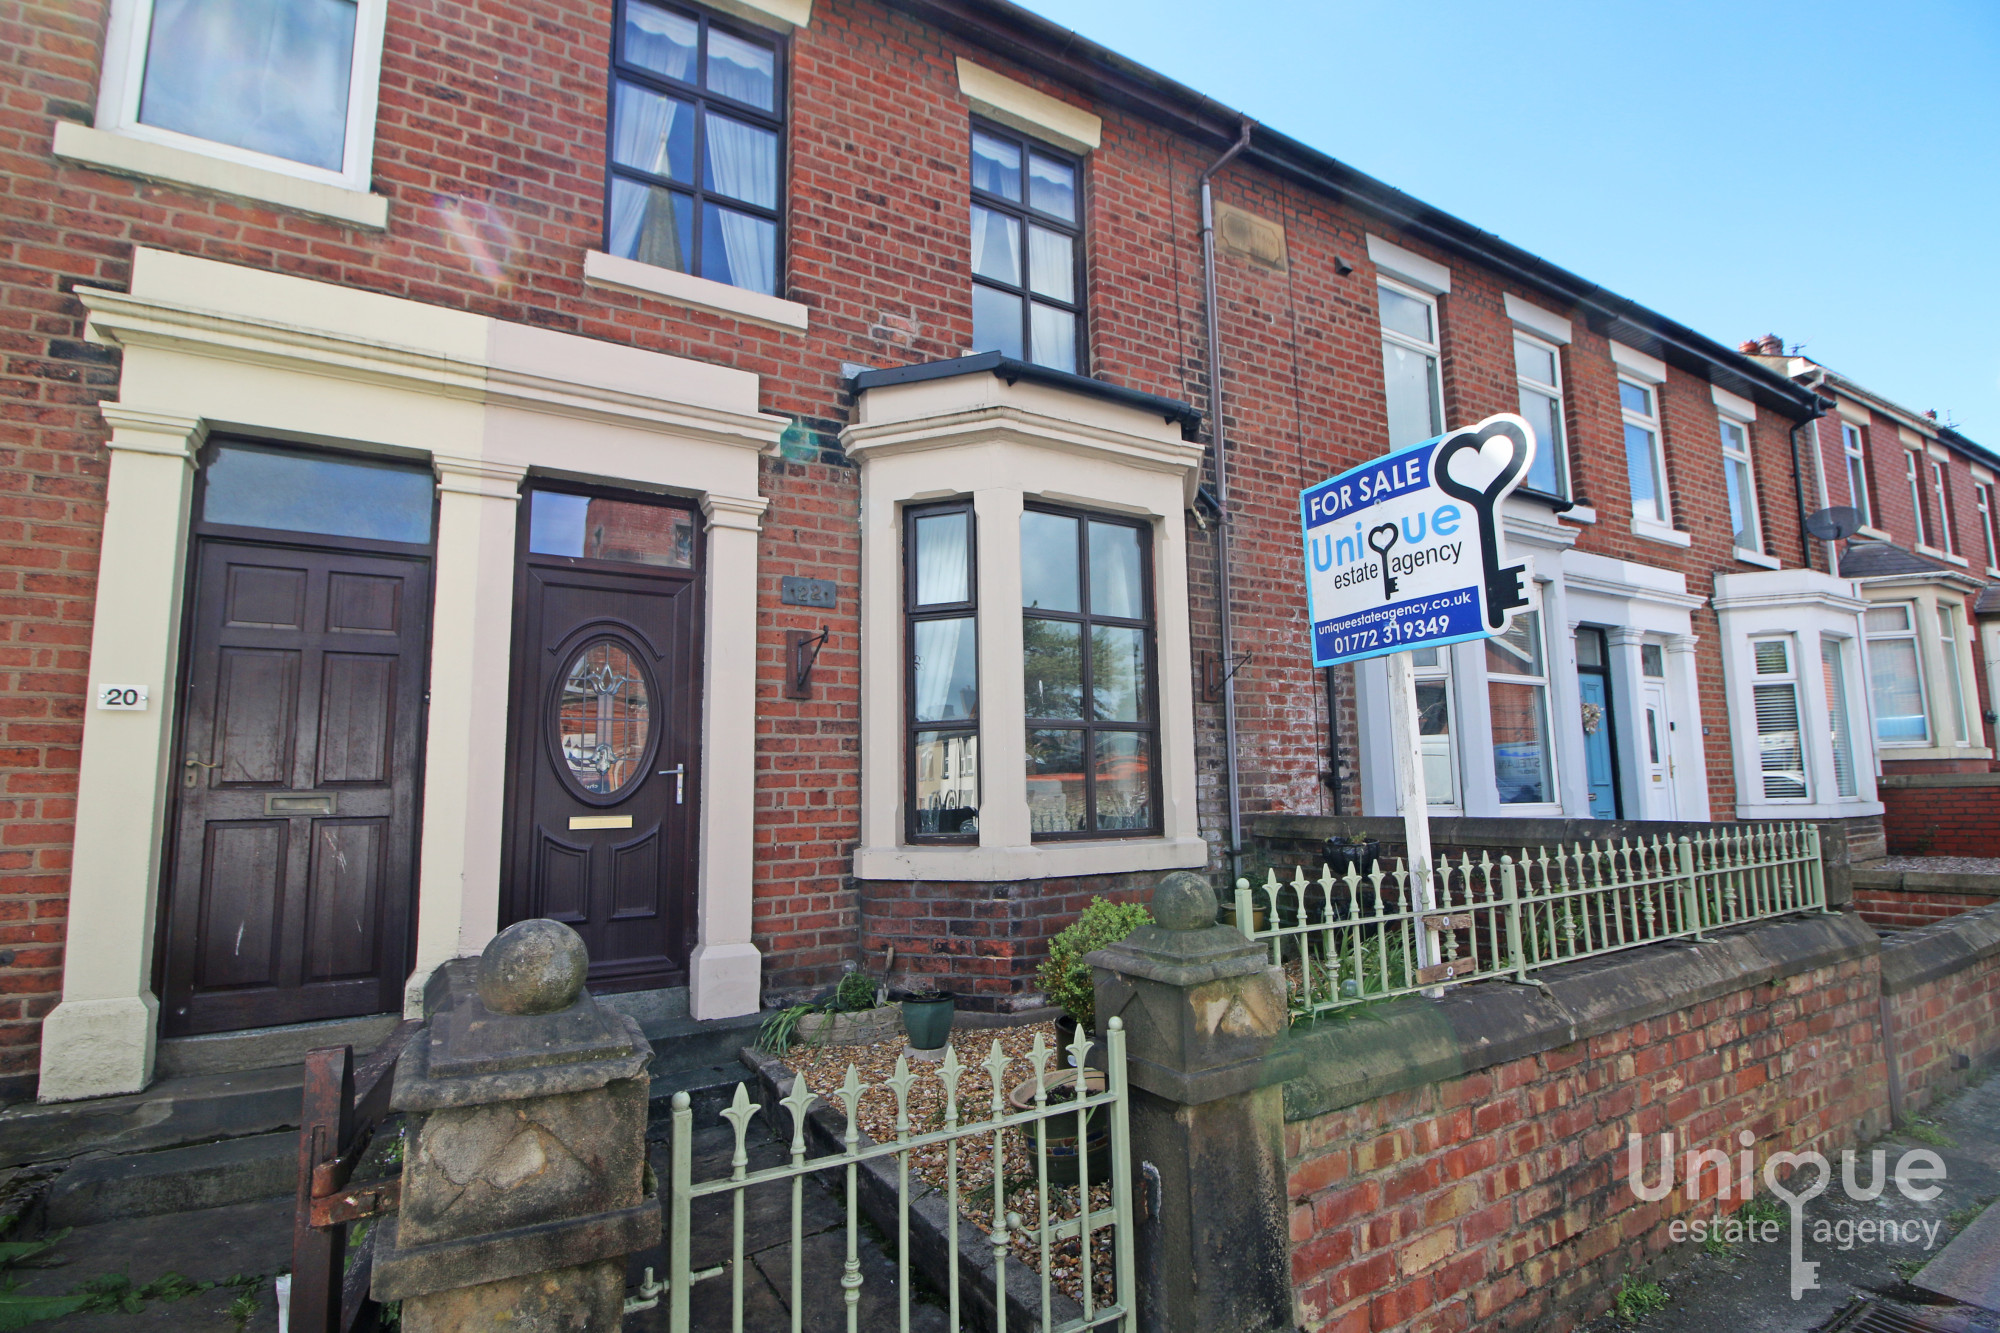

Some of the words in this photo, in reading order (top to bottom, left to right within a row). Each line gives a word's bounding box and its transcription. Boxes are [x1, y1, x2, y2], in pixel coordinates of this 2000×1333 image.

[1310, 482, 1353, 521] FOR
[1359, 457, 1421, 502] SALE
[1334, 561, 1378, 589] estate
[1391, 541, 1463, 576] agency
[798, 583, 822, 601] 22
[1318, 591, 1472, 635] uniqueestateagency.co.uk
[1334, 629, 1378, 654] 01772
[1382, 614, 1450, 644] 319349
[106, 688, 138, 706] 20
